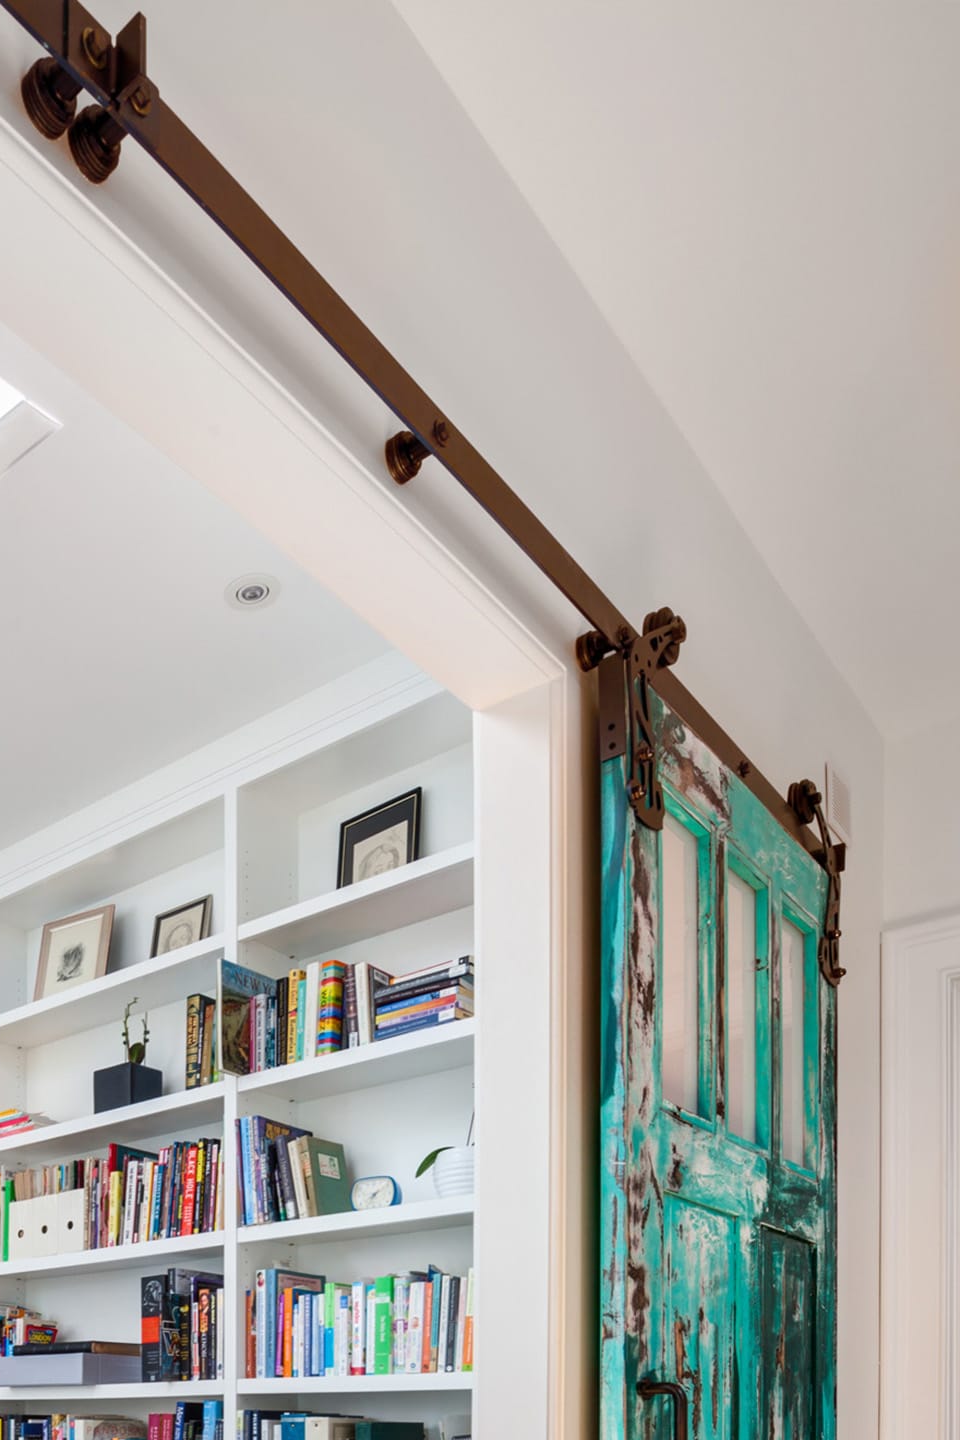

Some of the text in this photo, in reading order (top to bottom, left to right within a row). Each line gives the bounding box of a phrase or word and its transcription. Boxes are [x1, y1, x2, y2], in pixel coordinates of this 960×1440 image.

[233, 972, 260, 990] NEW
[188, 1150, 196, 1174] BLACK
[186, 1178, 194, 1200] HOLE
[175, 1406, 184, 1426] Mary
